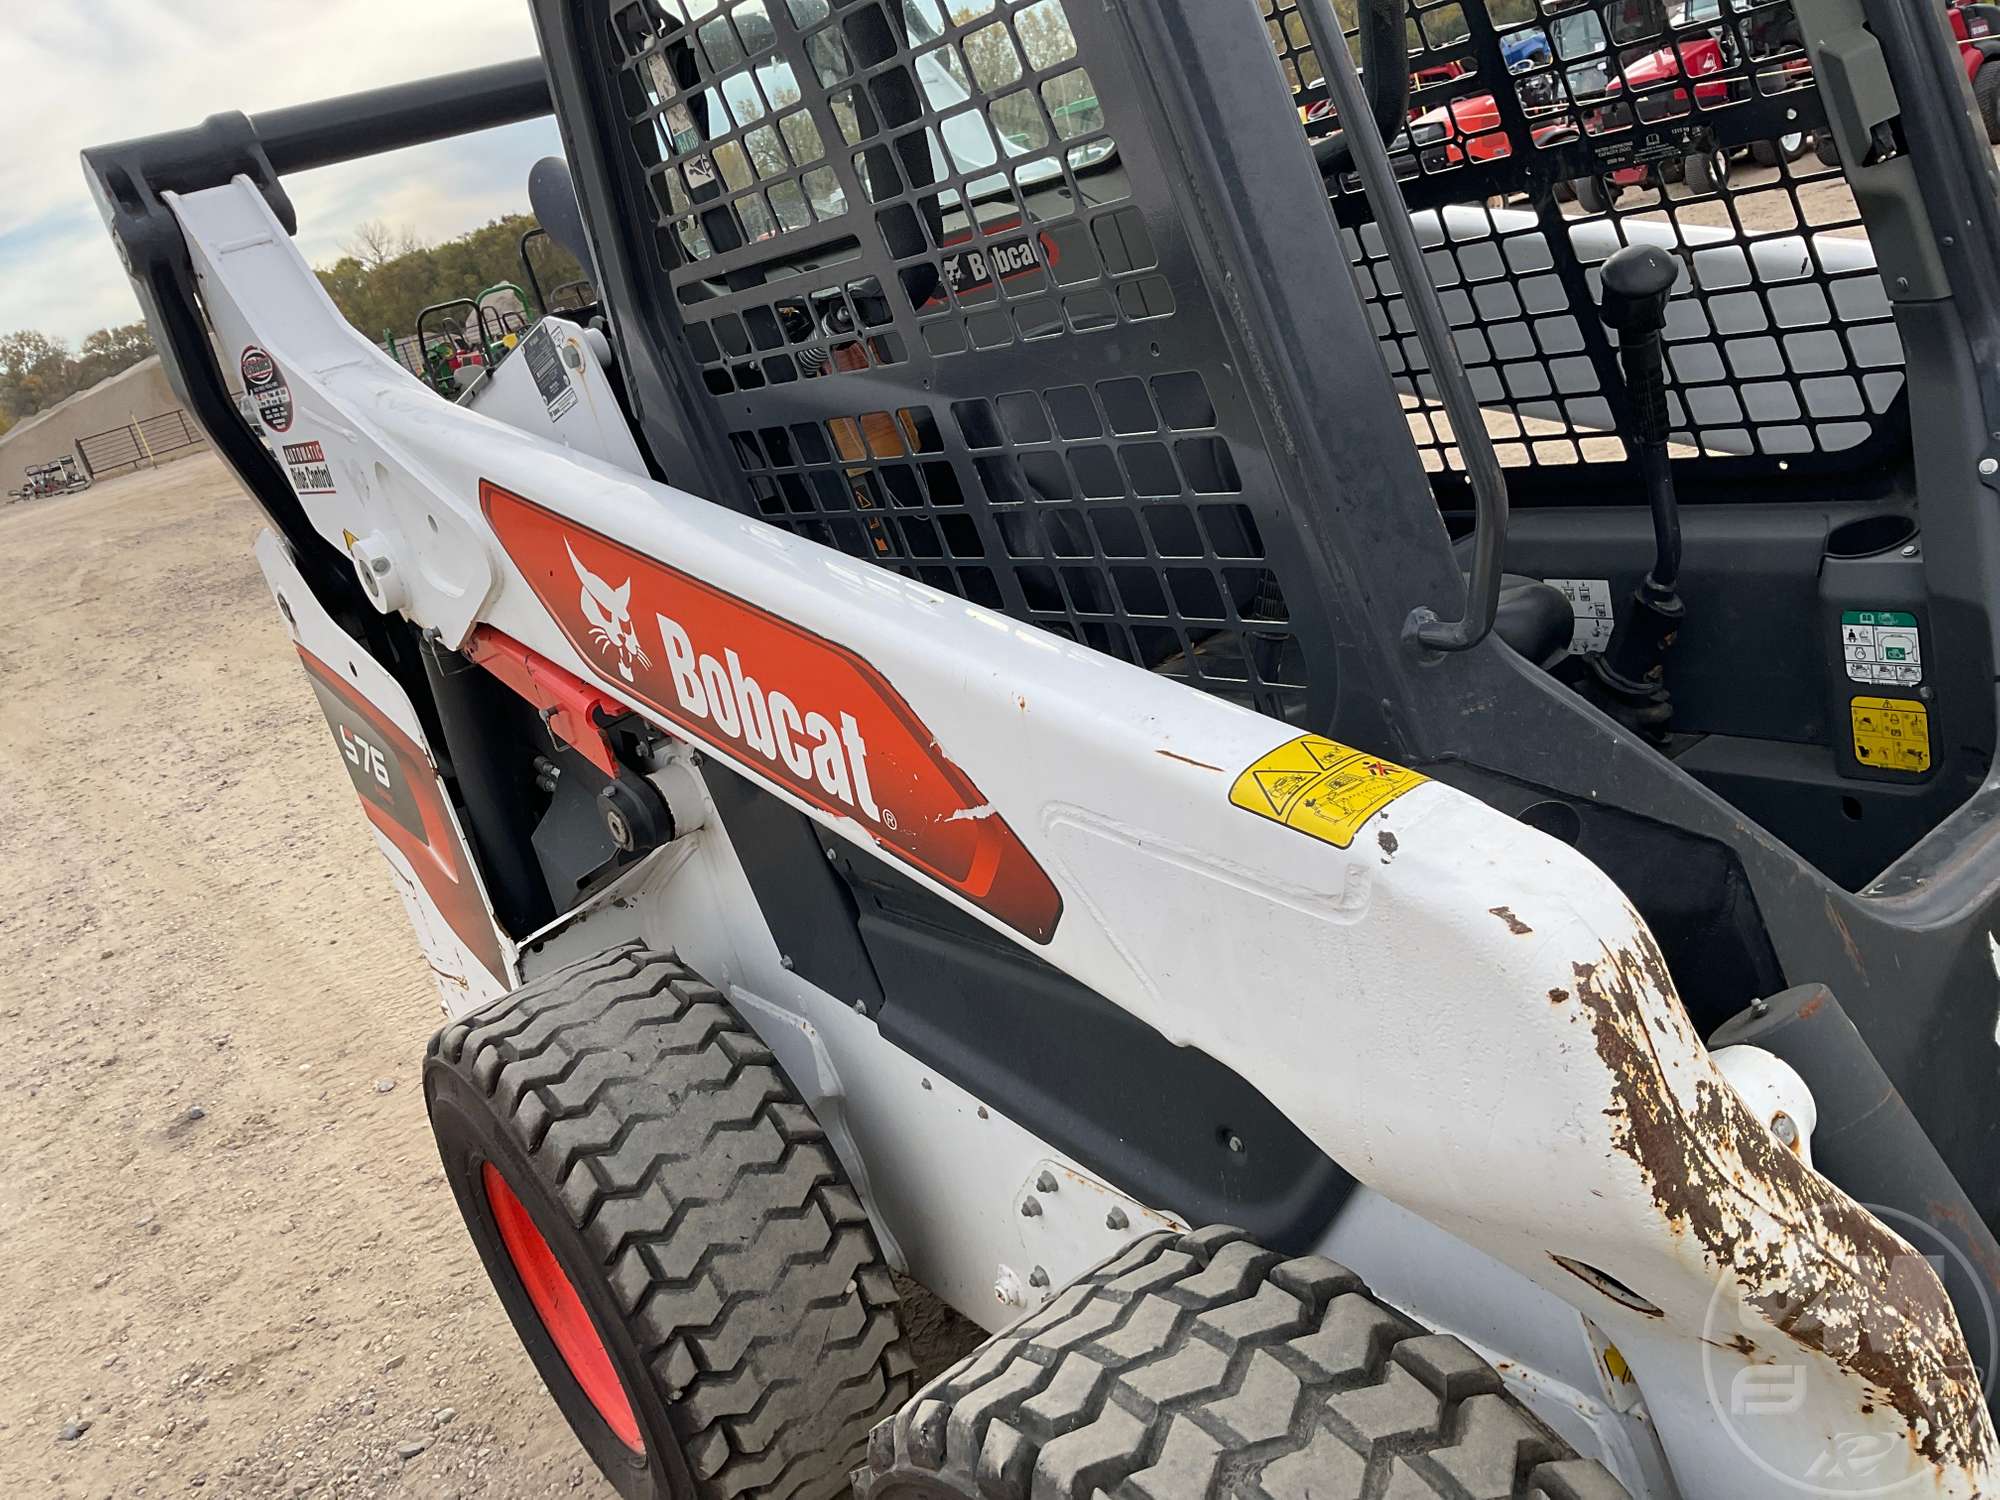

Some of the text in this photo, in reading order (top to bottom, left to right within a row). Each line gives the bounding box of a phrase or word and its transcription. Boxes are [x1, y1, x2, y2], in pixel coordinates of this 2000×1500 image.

[967, 238, 1039, 281] Bbca
[284, 443, 324, 463] AUTOMATIC
[305, 463, 335, 488] Control
[656, 611, 881, 823] Bobcat
